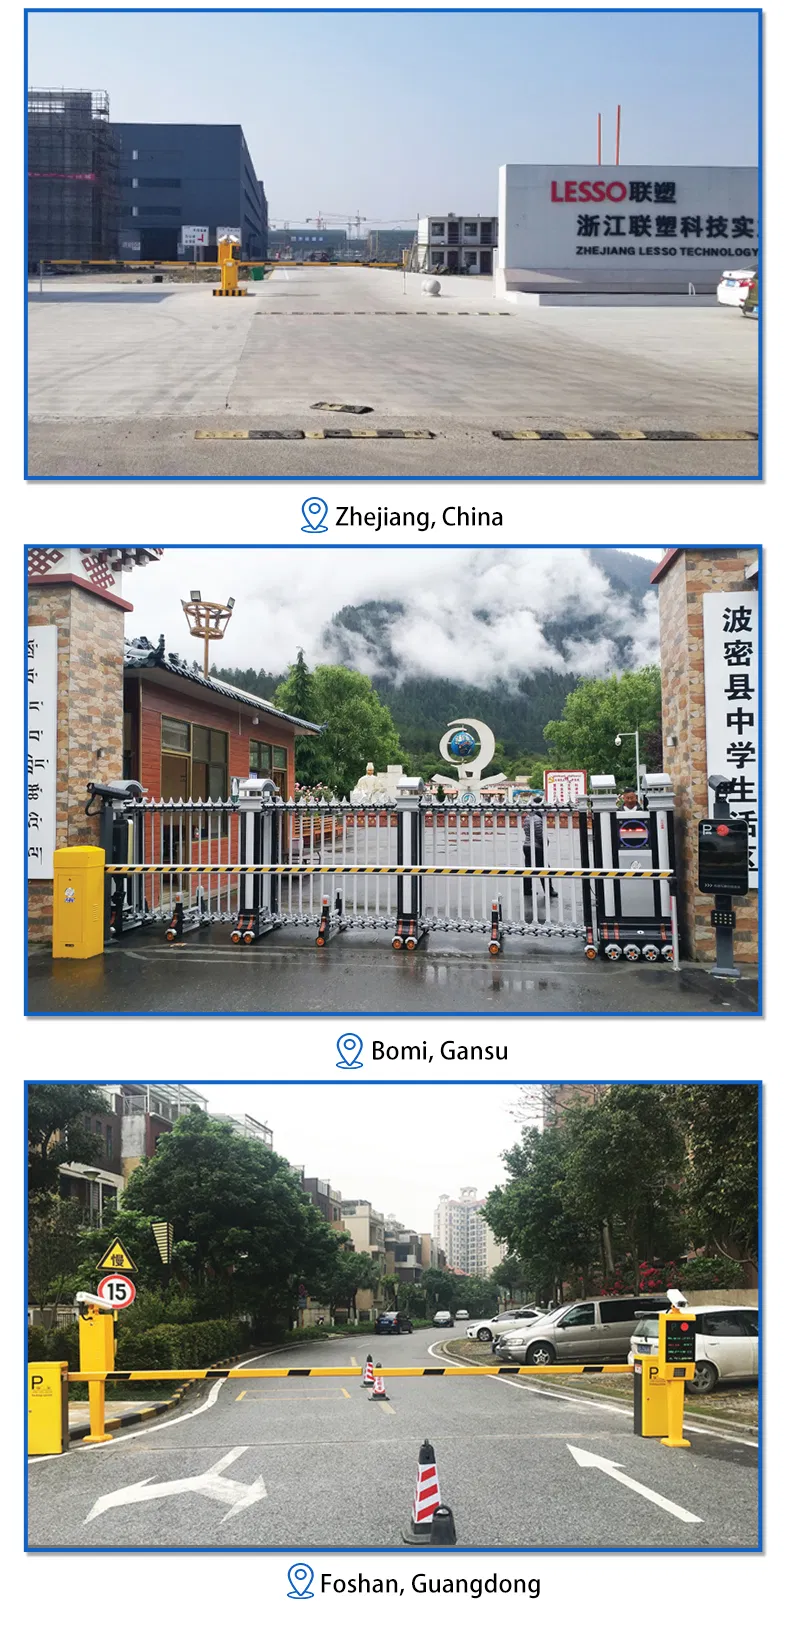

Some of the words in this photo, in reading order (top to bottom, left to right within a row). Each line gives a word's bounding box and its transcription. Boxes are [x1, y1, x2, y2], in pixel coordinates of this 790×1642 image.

[576, 214, 758, 239] 浙江联塑科技实
[576, 246, 635, 256] ZHEJIANG
[639, 246, 677, 256] LESSO
[680, 247, 758, 257] TECHNOLOGY
[110, 1253, 124, 1267] 慢
[107, 1283, 127, 1301] 15
[649, 1366, 659, 1380] P
[31, 1375, 44, 1390] P
